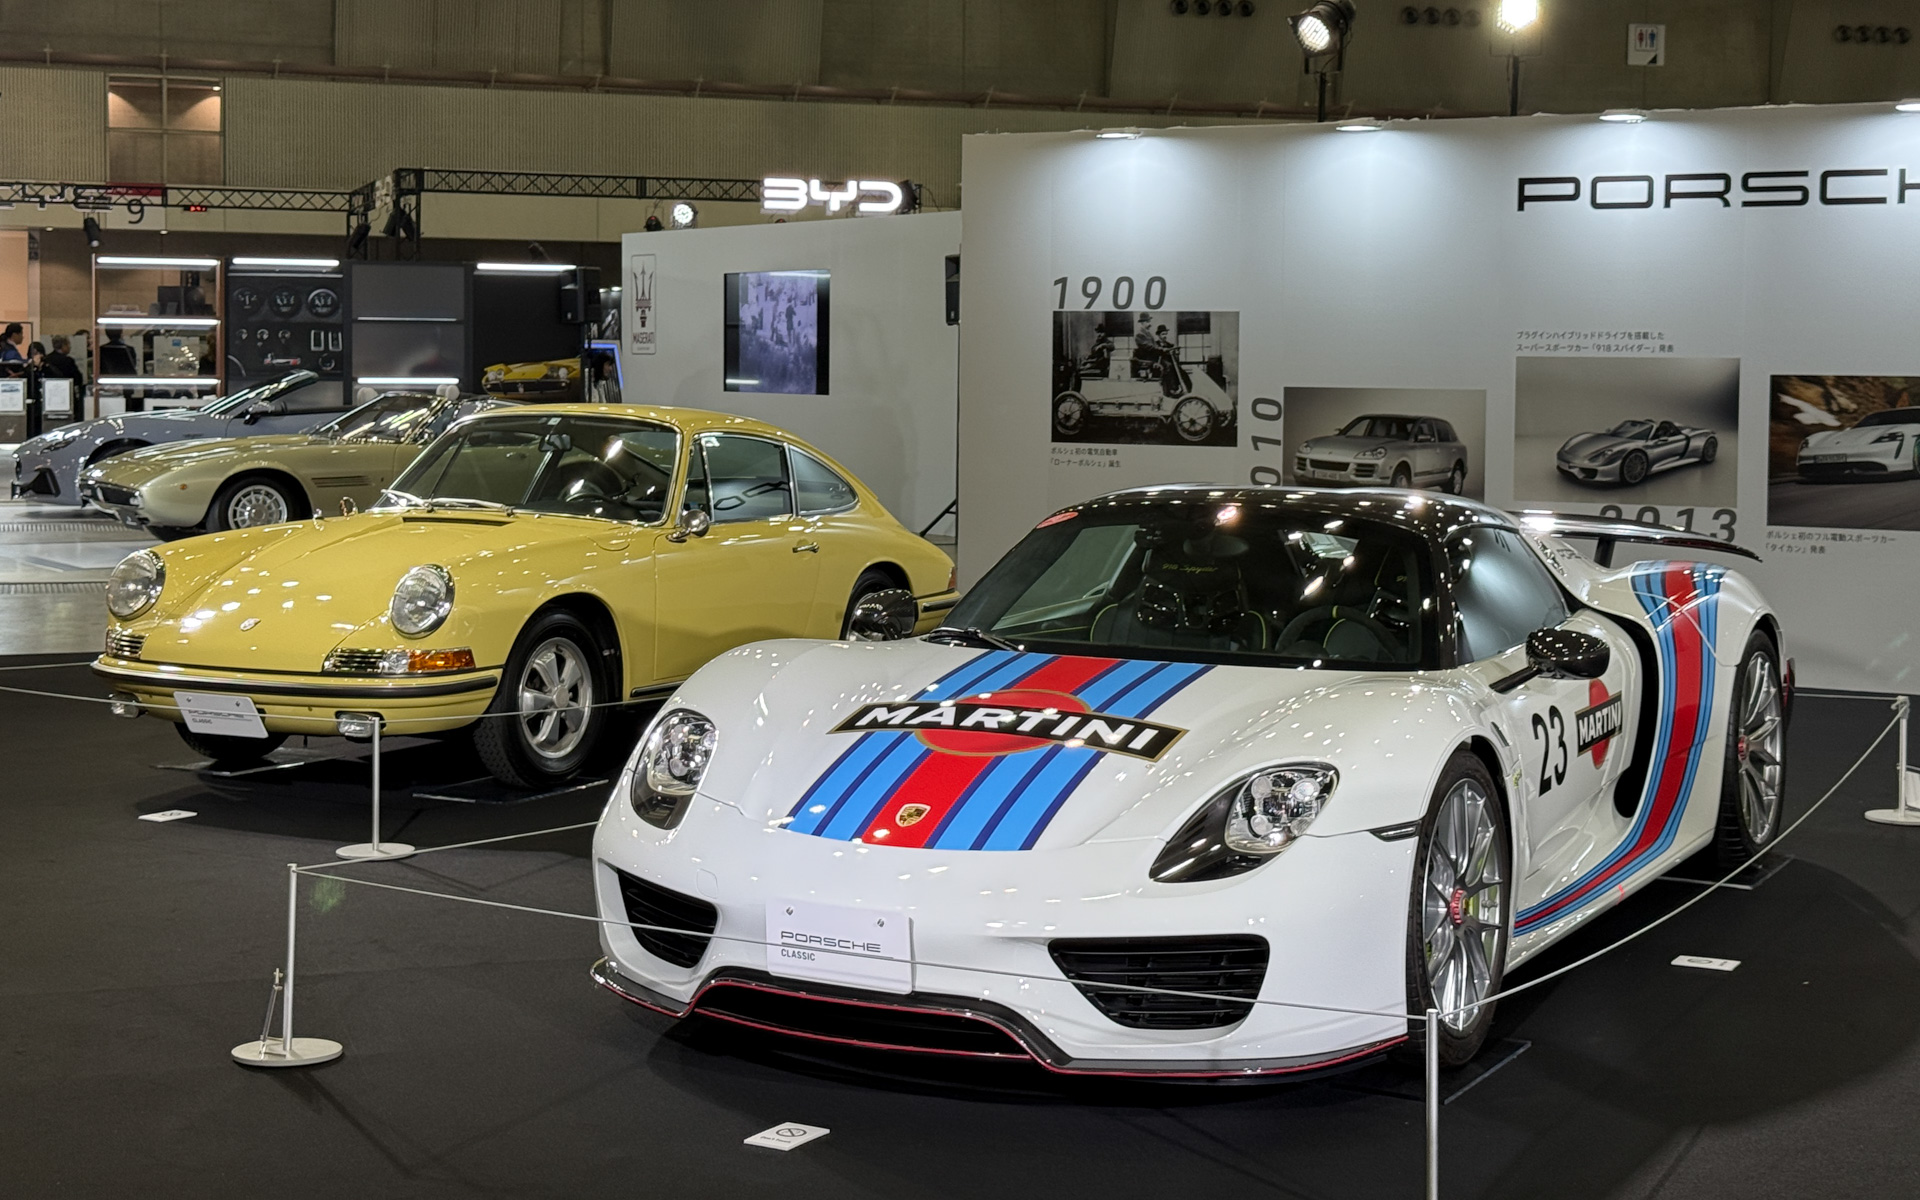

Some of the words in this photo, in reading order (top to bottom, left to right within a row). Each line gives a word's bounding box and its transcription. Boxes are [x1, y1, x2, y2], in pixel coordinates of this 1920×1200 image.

[127, 198, 144, 224] 9
[763, 177, 903, 212] BYD
[1053, 275, 1167, 310] 1900
[1250, 397, 1282, 486] 010
[855, 706, 1159, 751] MARTINI
[1579, 700, 1621, 746] MARTINI
[1532, 705, 1567, 797] 23
[781, 931, 881, 953] PORSCHE
[781, 948, 816, 961] CLASSIC
